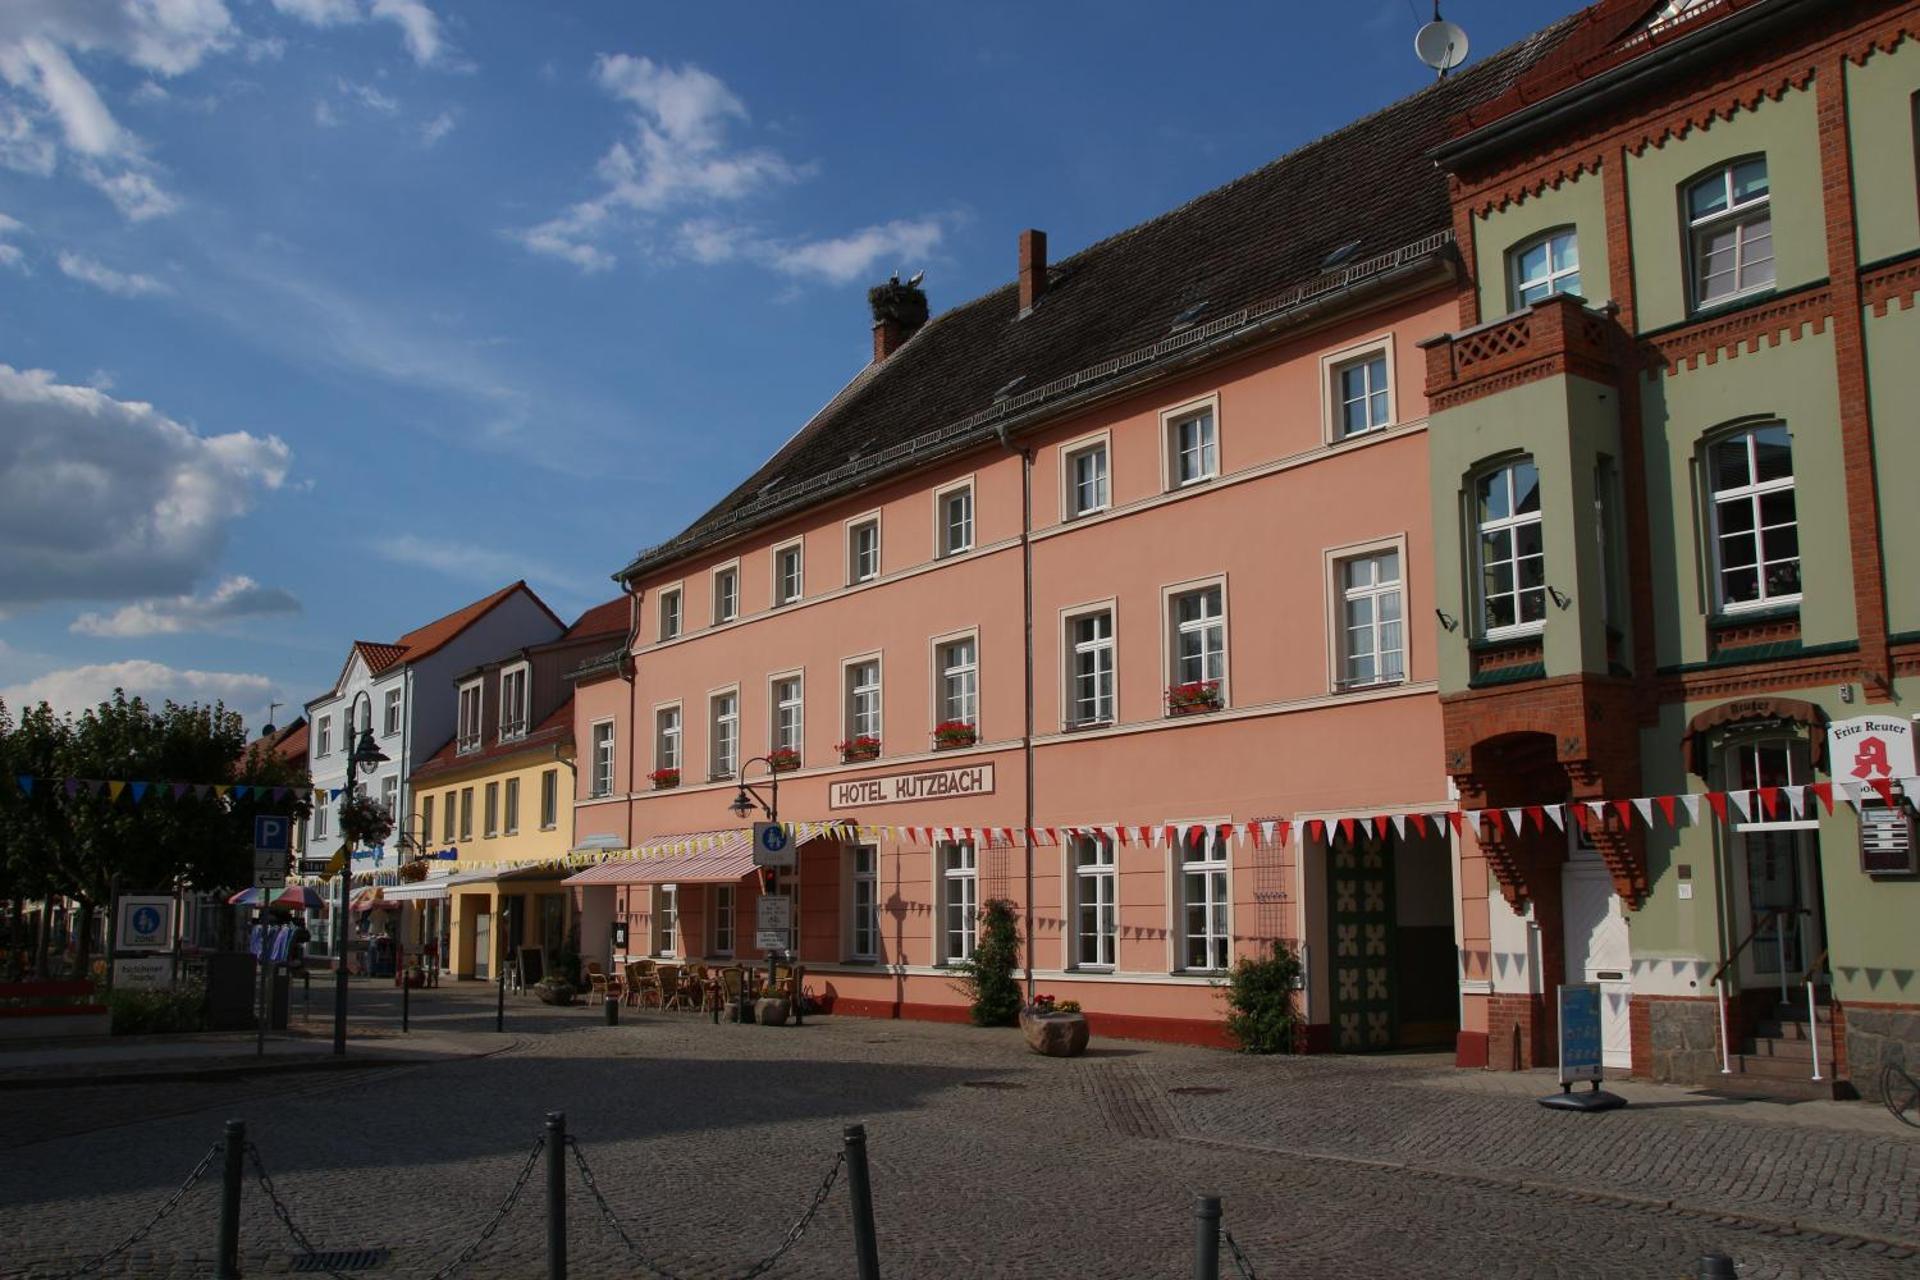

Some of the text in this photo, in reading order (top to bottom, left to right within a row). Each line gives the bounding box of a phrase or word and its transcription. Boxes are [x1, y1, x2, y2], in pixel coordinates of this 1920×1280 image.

[1730, 700, 1770, 713] Reuter
[1833, 721, 1906, 740] Fritz Reuter
[838, 768, 983, 804] HOTEL KUTZBACH
[262, 820, 280, 847] P
